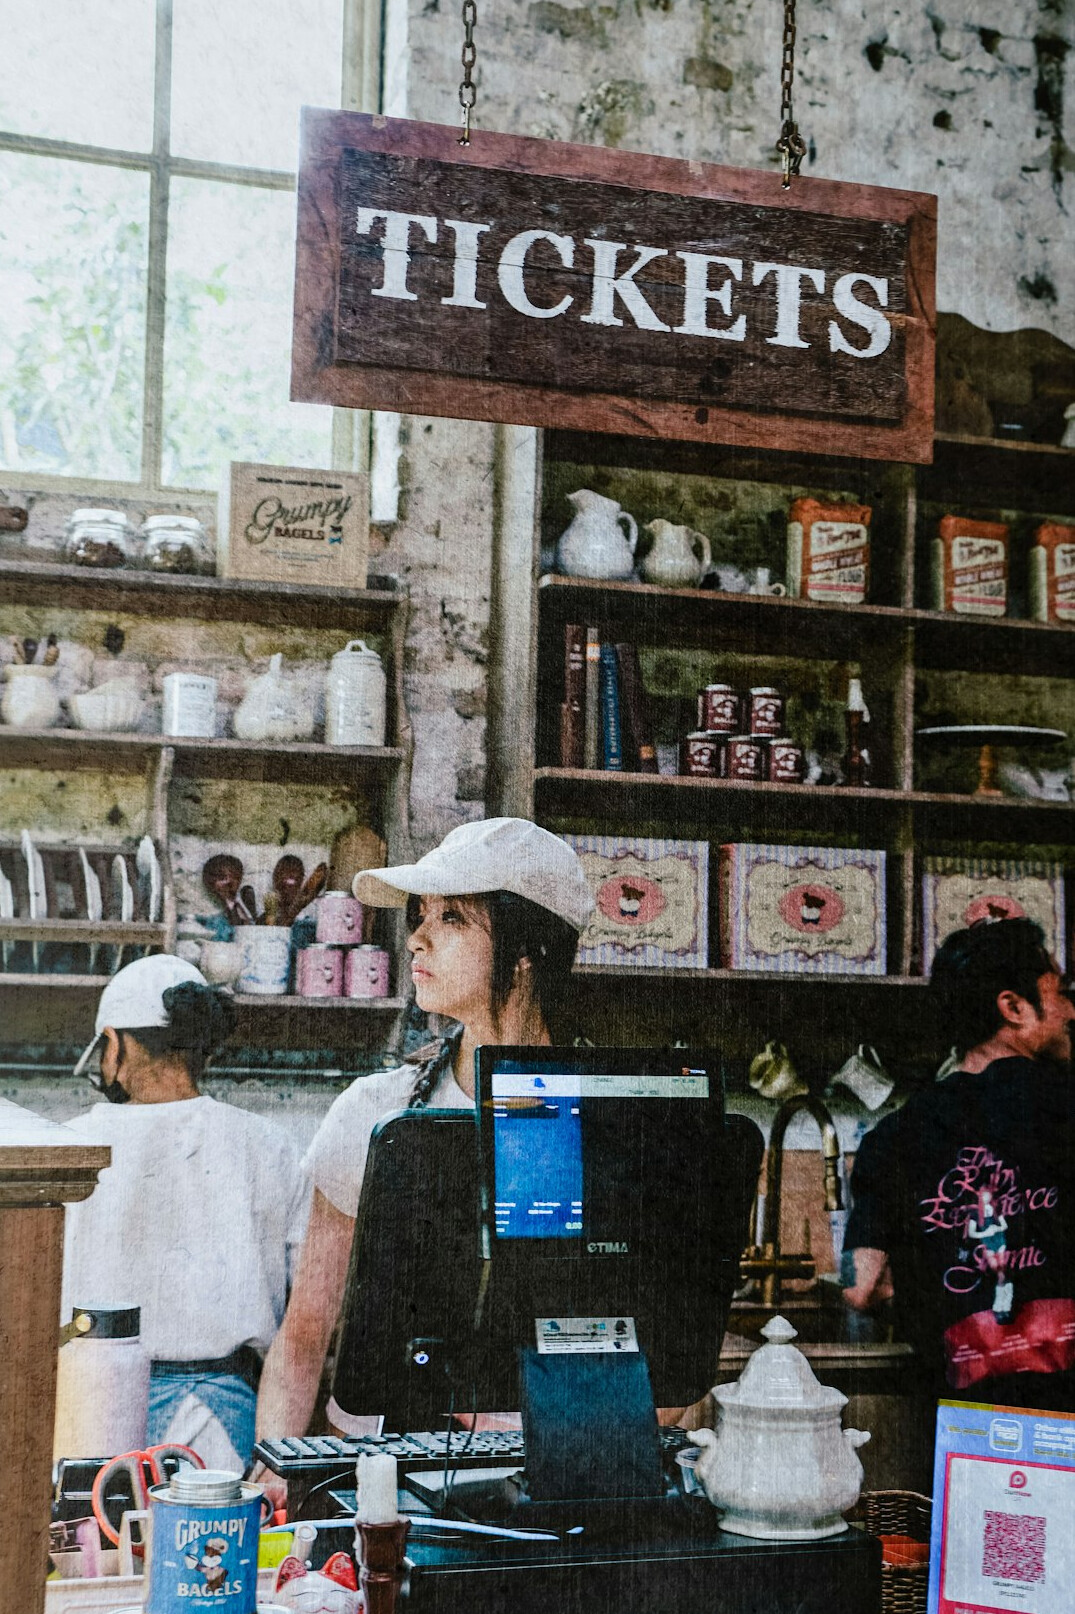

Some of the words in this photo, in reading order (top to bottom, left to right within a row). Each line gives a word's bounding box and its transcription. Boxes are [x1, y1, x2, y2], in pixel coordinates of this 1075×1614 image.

[356, 206, 893, 359] TICKETS
[245, 495, 351, 545] Grumpy
[274, 526, 325, 541] BAGELS
[175, 1517, 248, 1551] GRUMPY
[177, 1580, 242, 1597] BAGELS
